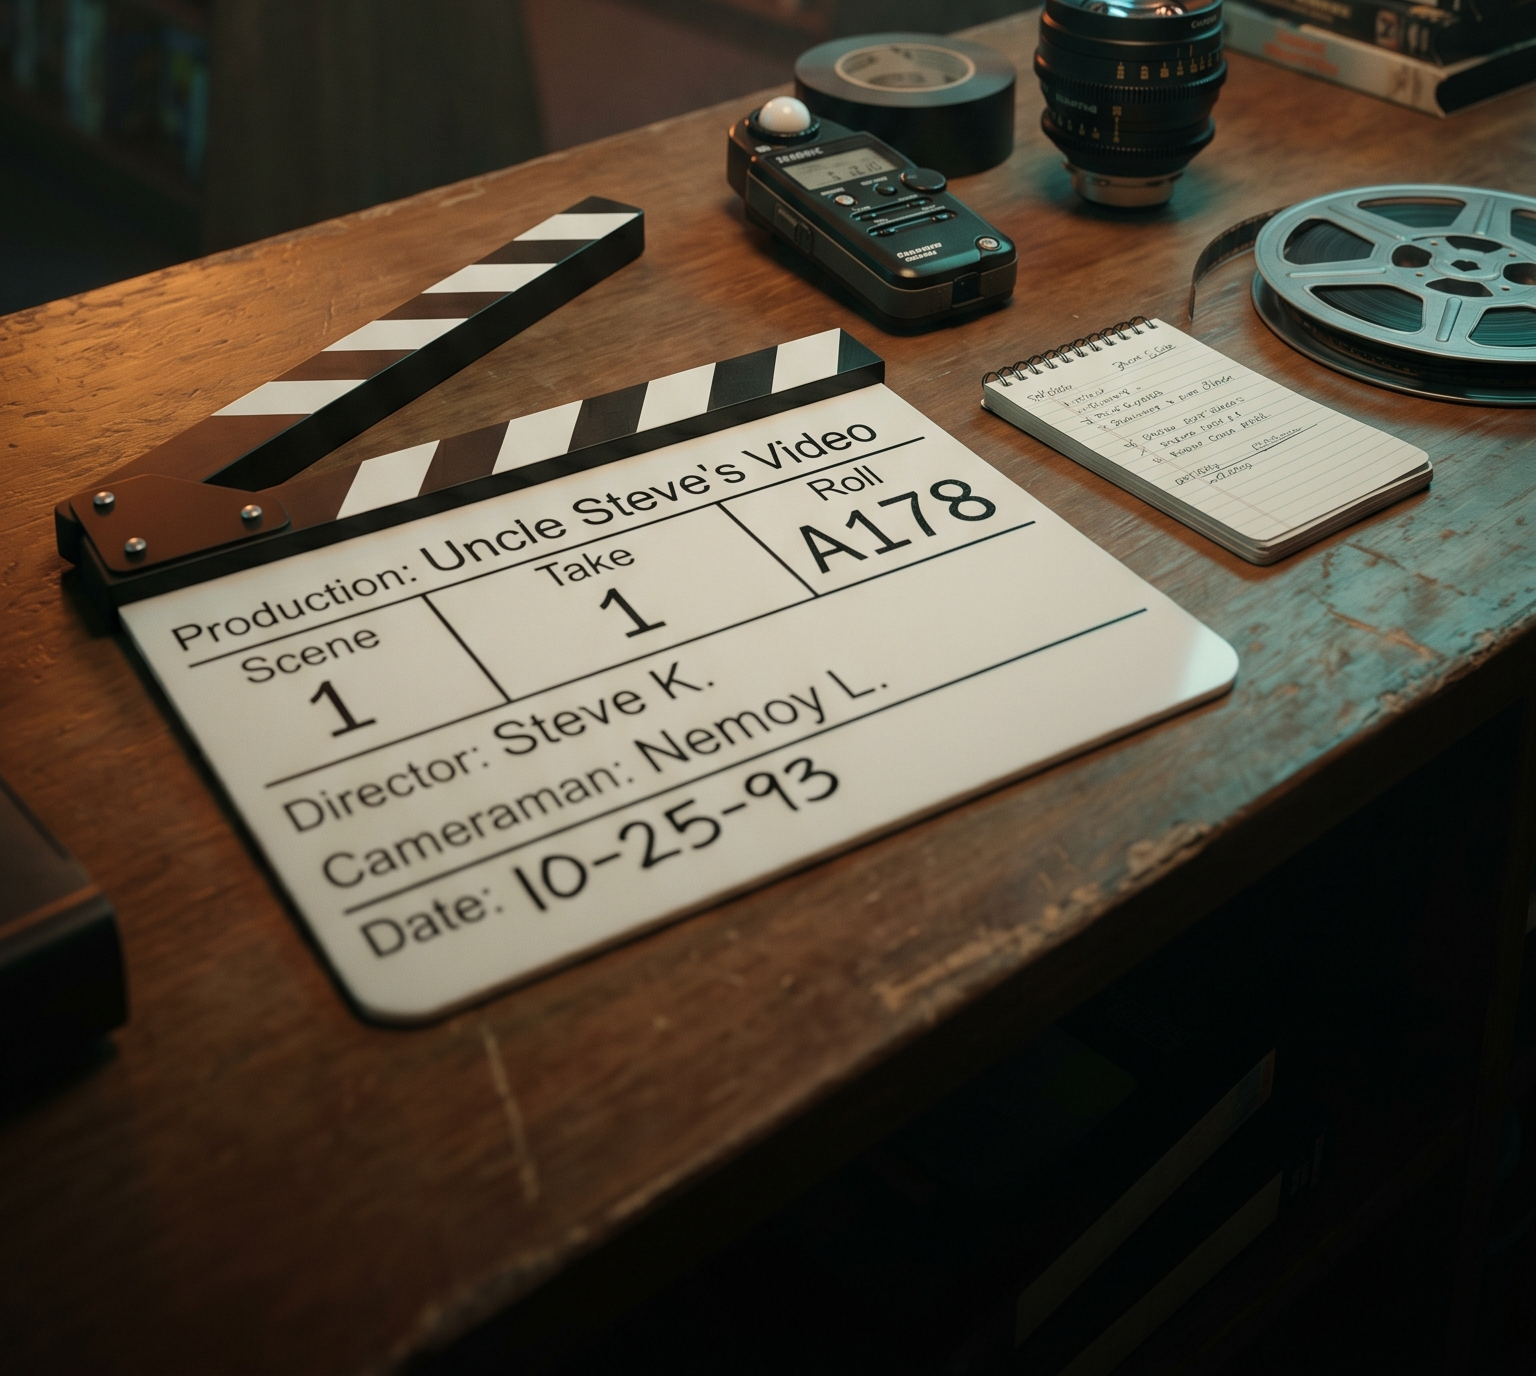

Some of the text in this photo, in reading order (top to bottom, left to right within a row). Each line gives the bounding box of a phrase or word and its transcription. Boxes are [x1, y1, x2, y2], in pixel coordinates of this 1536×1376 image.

[805, 464, 885, 503] Roll
[170, 422, 878, 652] Production: Uncle Steve's Video
[797, 477, 998, 576] A178
[533, 546, 636, 590] Take
[598, 586, 668, 640] 1
[240, 628, 381, 684] Scene
[282, 660, 716, 834] Director: Steve K.
[308, 679, 378, 739] 1
[321, 669, 890, 890] Cameraman: Nemoy L.
[358, 755, 841, 960] Date: 10-25-93
